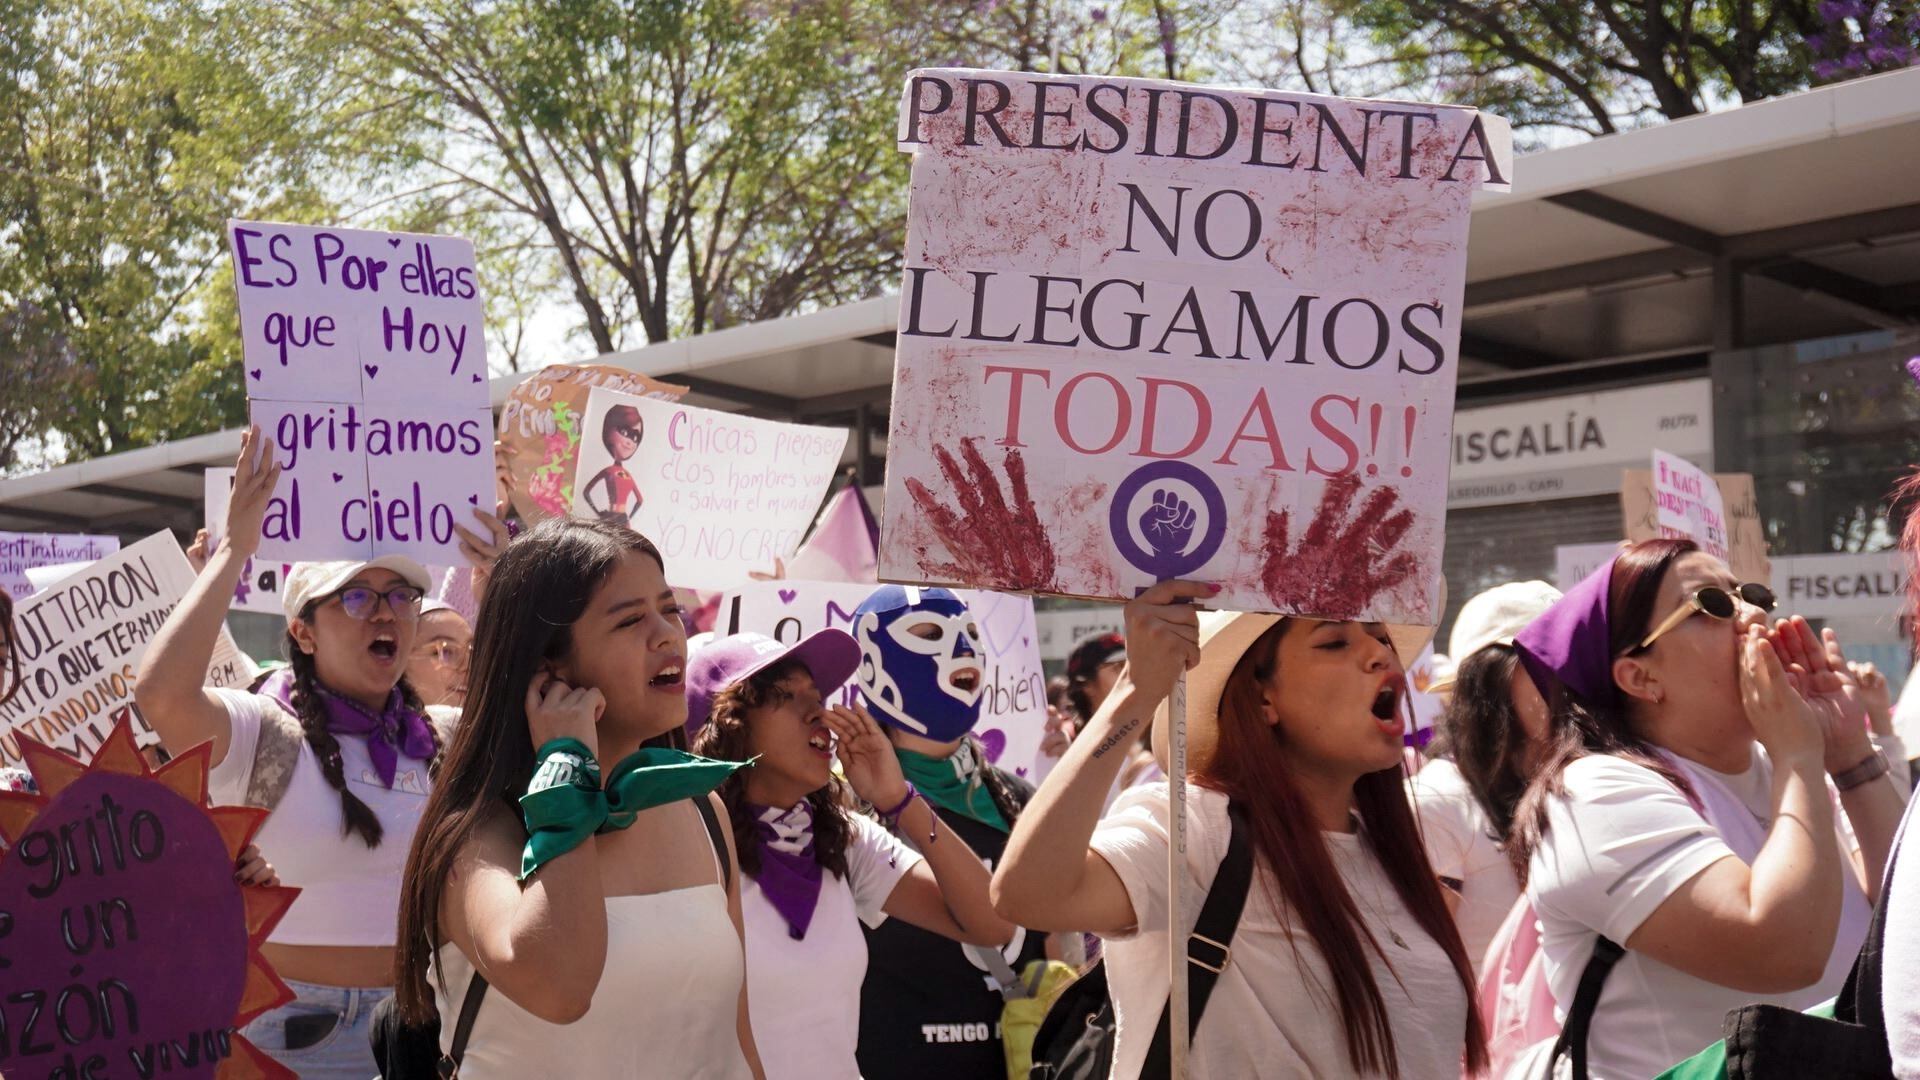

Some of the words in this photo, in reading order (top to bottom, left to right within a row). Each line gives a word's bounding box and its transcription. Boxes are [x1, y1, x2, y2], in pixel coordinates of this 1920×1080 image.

[900, 75, 1511, 186] PRESIDENTA
[1115, 182, 1263, 261] NO
[234, 227, 298, 288] ES
[314, 232, 388, 292] Por
[400, 242, 476, 299] ellas
[264, 312, 337, 366] que
[382, 305, 467, 375] Hoy
[900, 266, 1446, 376] LLEGAMOS
[276, 405, 481, 471] gritamos
[668, 410, 757, 455] Chicas
[982, 365, 1418, 479] TODAS!!
[1455, 410, 1606, 466] ISCALÍA
[262, 478, 300, 542] al
[341, 480, 453, 545] cielo
[728, 462, 797, 497] hombres
[1450, 481, 1517, 499] LSEQUILLO
[656, 515, 687, 558] YO
[694, 524, 735, 561] NO
[5, 555, 160, 672] UITARON
[0, 667, 59, 723] NTO
[58, 639, 104, 685] QUE
[210, 660, 237, 688] 8M
[19, 793, 165, 899] grito
[61, 896, 139, 955] un
[128, 1026, 239, 1080] vivir
[921, 1023, 990, 1043] TENGO
